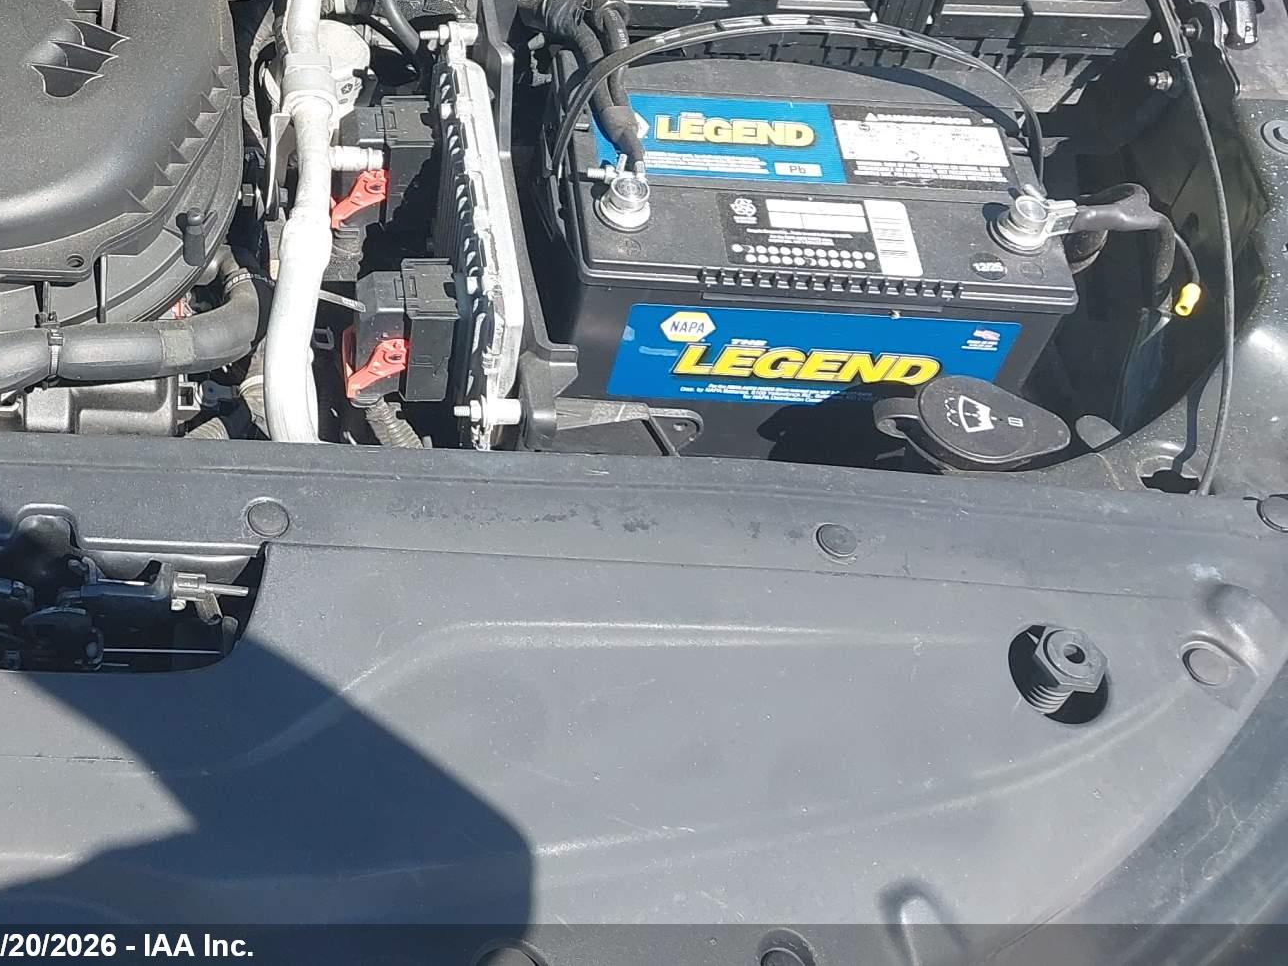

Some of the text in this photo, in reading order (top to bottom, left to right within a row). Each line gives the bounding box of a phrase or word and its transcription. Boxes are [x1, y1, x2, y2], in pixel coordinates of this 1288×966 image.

[655, 114, 816, 148] LEGEND
[789, 165, 806, 175] Pb
[669, 320, 706, 334] NAPA
[670, 342, 942, 386] LEGEND
